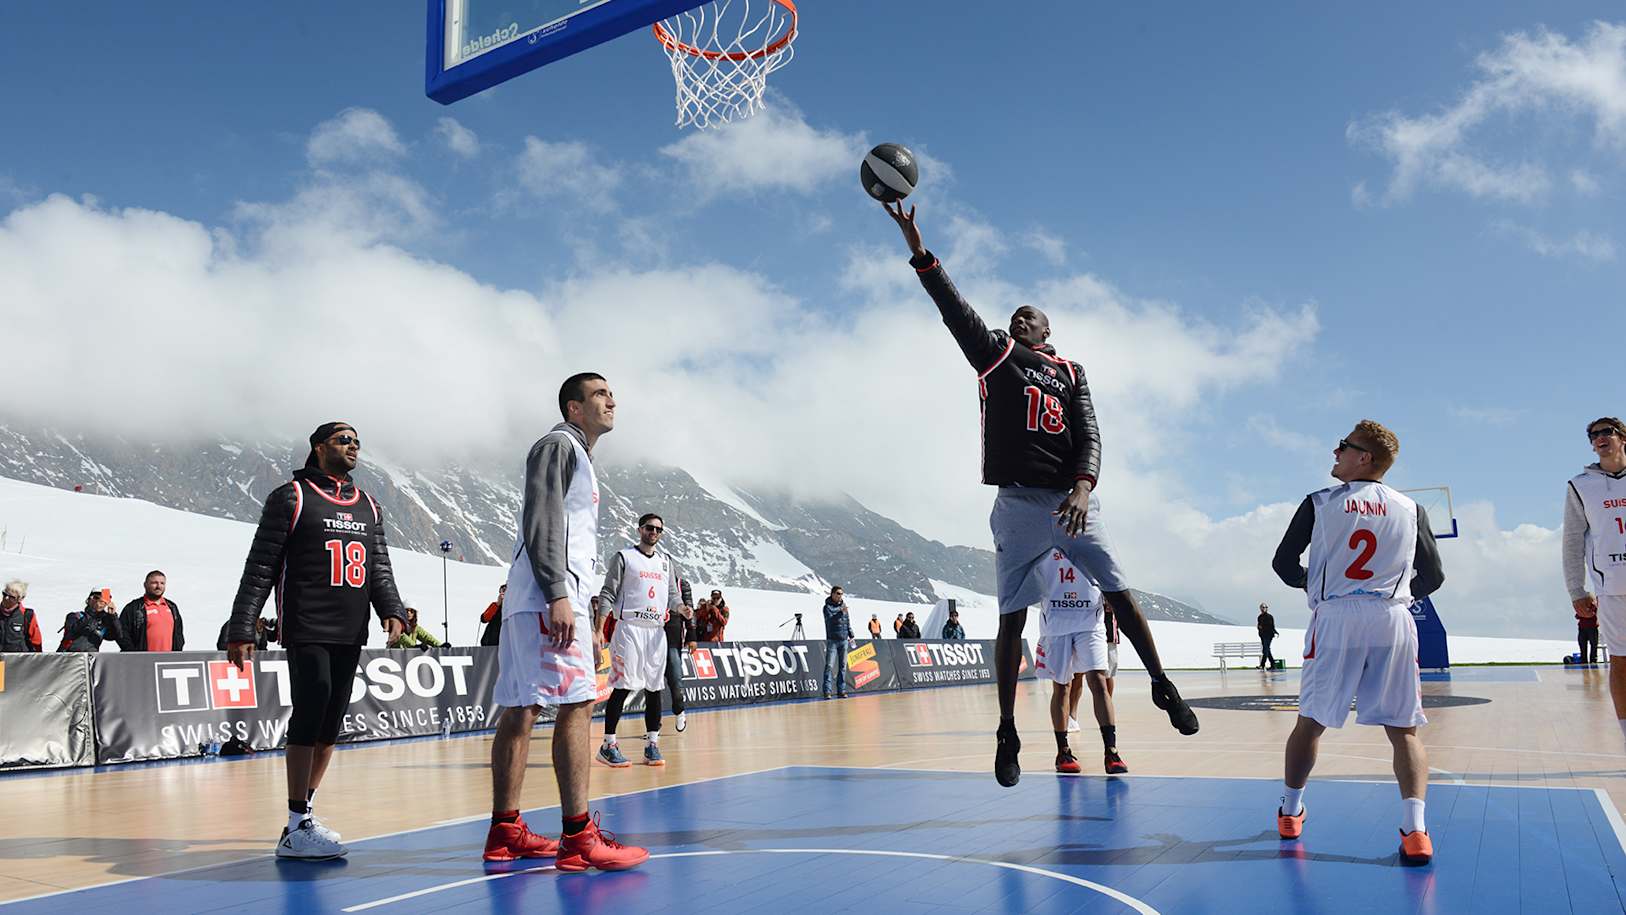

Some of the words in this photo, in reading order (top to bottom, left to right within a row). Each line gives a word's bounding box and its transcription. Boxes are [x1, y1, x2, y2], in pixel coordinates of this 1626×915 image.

[1024, 367, 1066, 393] TISSOT
[1024, 385, 1066, 434] 18
[1344, 499, 1387, 516] JAUNIN
[323, 518, 367, 532] TISSOT
[1615, 517, 1626, 535] 1
[325, 539, 367, 588] 18
[1344, 529, 1378, 580] 2
[1059, 567, 1076, 584] 14
[648, 586, 656, 599] 6
[1050, 600, 1091, 608] TISSOT
[712, 645, 809, 678] TISSOT
[927, 643, 985, 666] TISSOT
[259, 655, 473, 703] TSOT
[913, 671, 934, 683] SWISS
[934, 669, 961, 681] WATCHES
[961, 668, 978, 679] SINCE
[720, 681, 767, 699] WATCHES
[770, 680, 798, 694] SINCE
[160, 720, 250, 746] SWISS
[377, 706, 441, 729] SINCE
[447, 704, 486, 724] 1853
